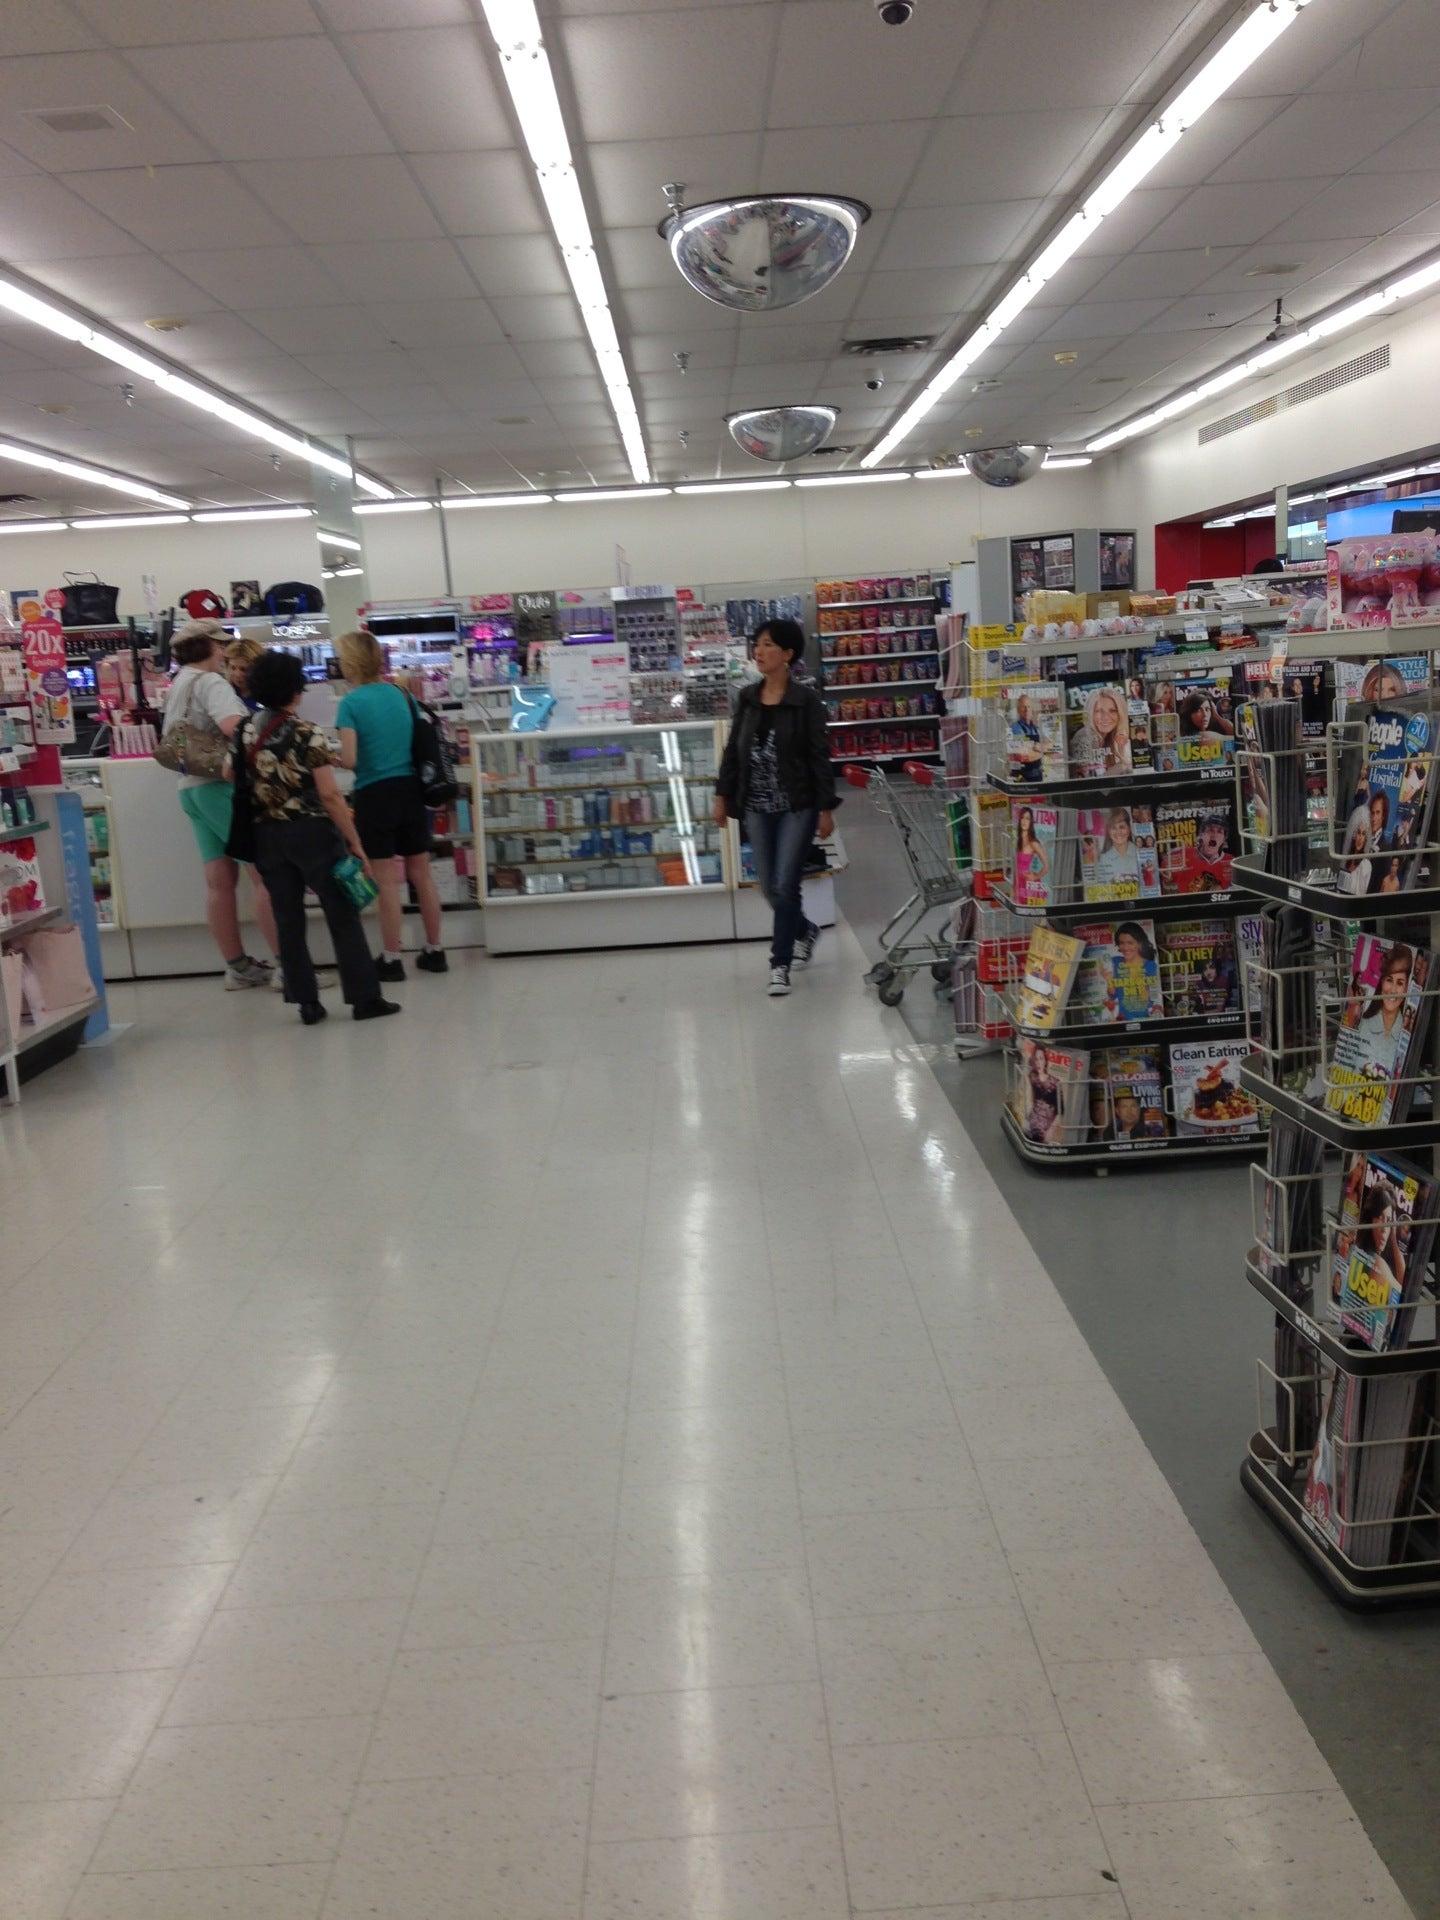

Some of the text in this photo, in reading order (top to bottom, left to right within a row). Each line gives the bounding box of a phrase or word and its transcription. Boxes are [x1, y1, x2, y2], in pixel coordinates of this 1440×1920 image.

[1398, 660, 1424, 670] STYLE
[1401, 669, 1425, 679] ATCH
[1368, 714, 1403, 750] People
[1178, 741, 1222, 762] Used
[1368, 767, 1403, 789] Hospital
[1156, 804, 1232, 822] SPORTSNET
[1210, 893, 1232, 903] Star
[1185, 946, 1214, 961] THEY
[1172, 1045, 1249, 1061] Clean Eating
[1132, 1085, 1161, 1097] LIVING
[1343, 1091, 1384, 1124] BABY
[1349, 1258, 1389, 1307] Used
